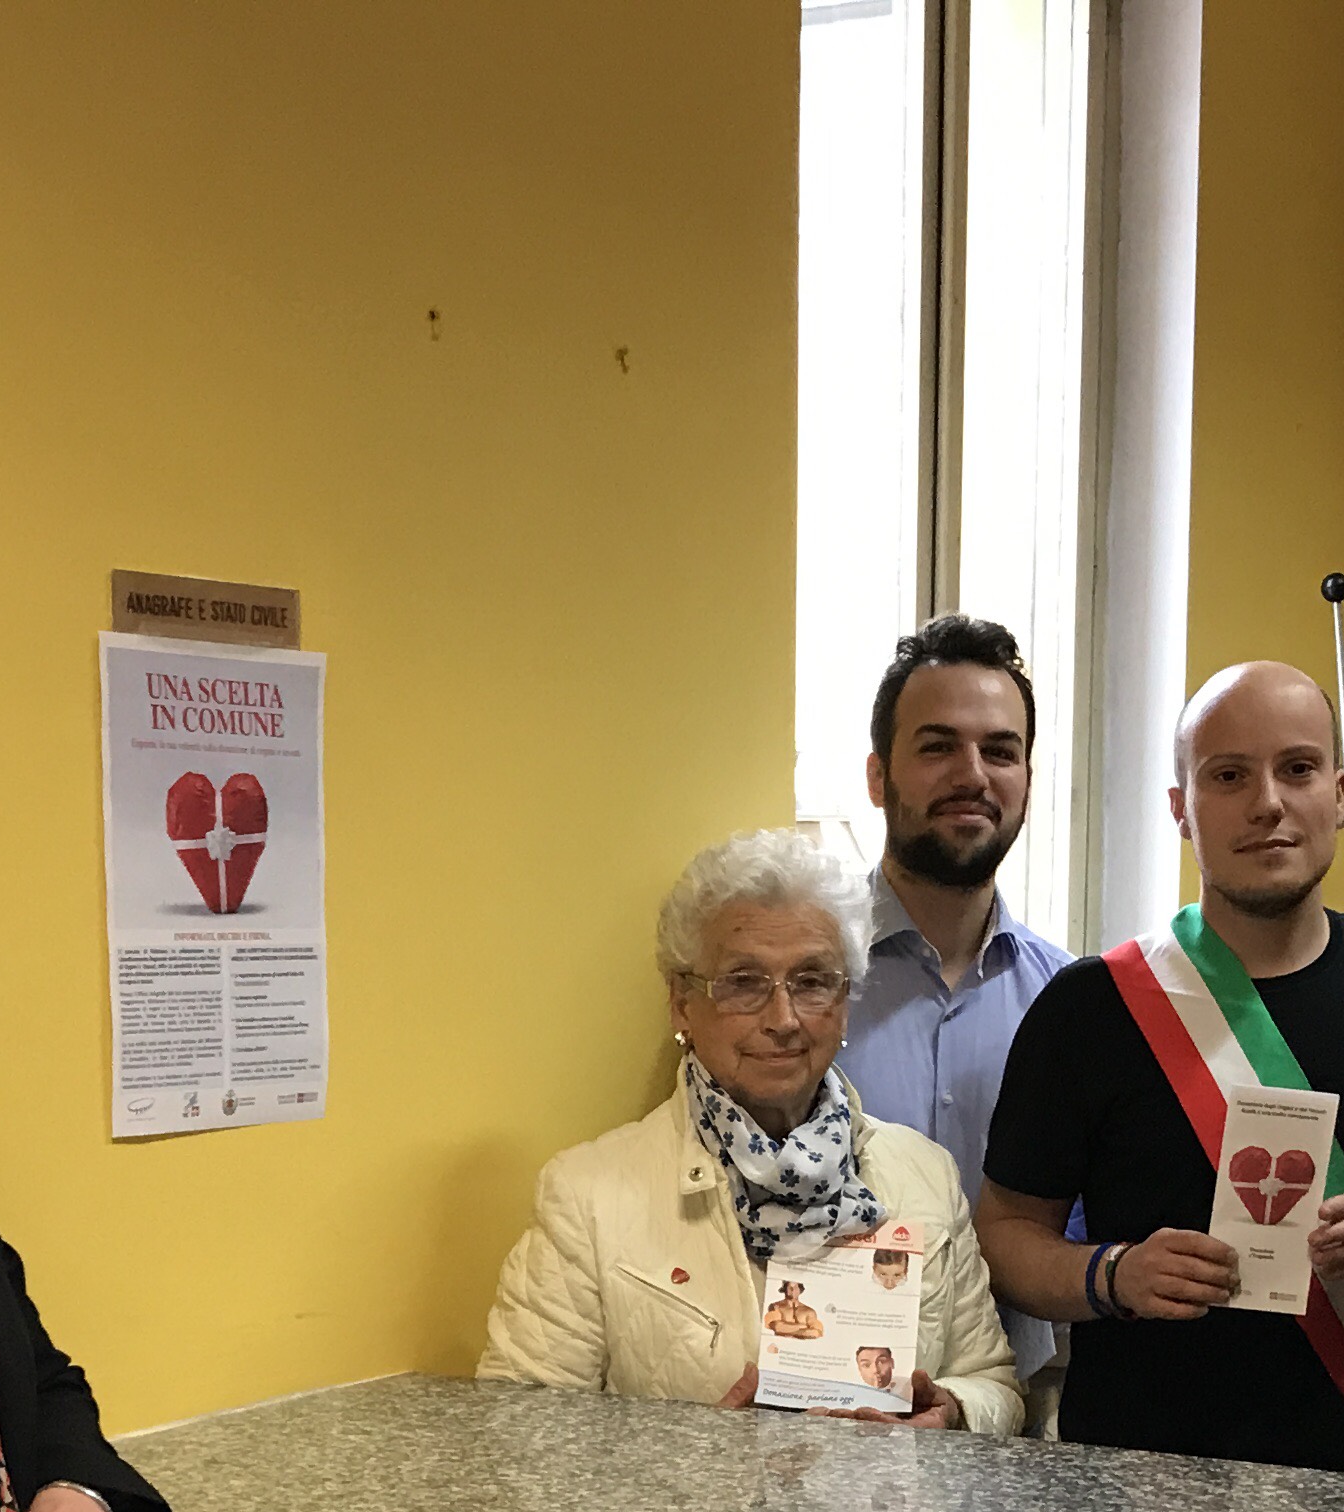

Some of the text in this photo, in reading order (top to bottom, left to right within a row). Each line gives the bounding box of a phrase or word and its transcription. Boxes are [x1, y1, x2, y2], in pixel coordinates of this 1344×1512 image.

[127, 592, 288, 628] ANAGRAFE E STATO CIVILE
[146, 672, 284, 708] UNA SCELTA
[150, 704, 284, 738] IN COMUNE
